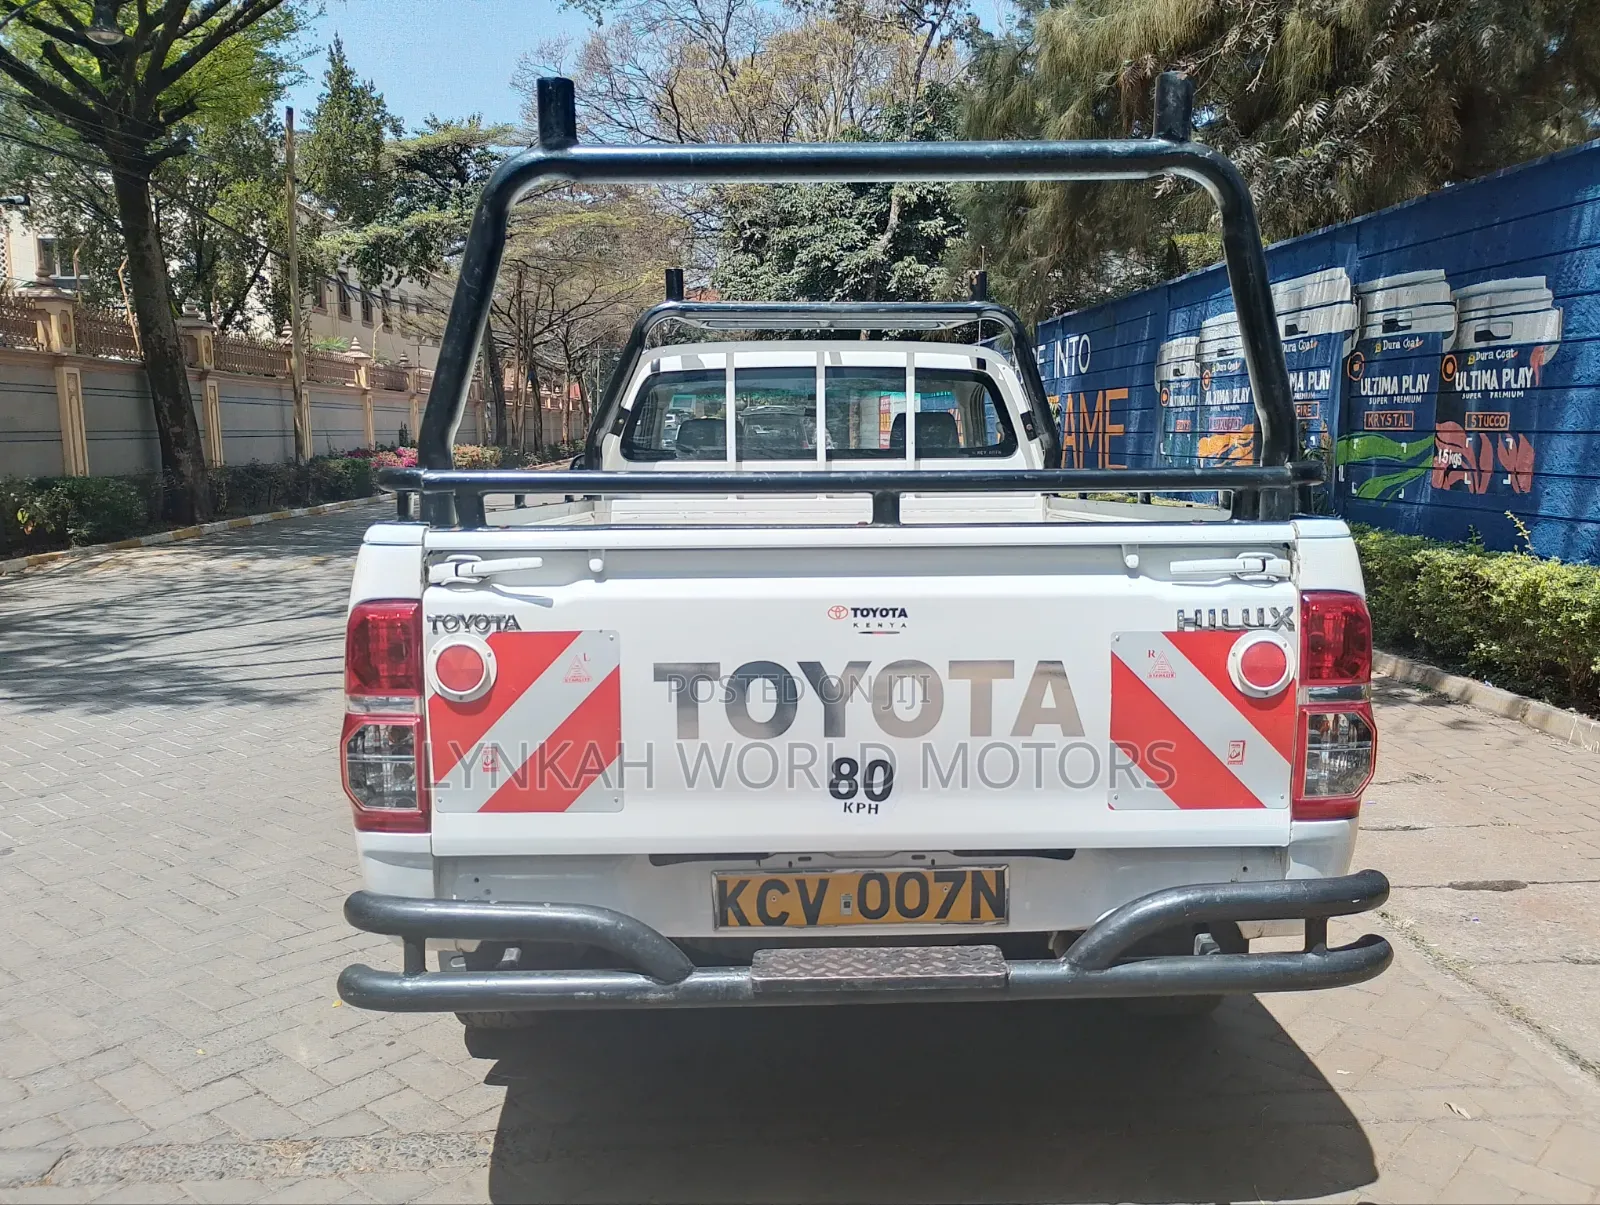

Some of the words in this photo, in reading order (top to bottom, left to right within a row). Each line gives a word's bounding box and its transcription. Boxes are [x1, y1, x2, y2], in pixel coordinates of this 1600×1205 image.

[1298, 339, 1316, 353] Coat
[1383, 339, 1401, 351] Dura
[1402, 336, 1421, 351] Coat
[1054, 334, 1091, 379] INTO
[1475, 351, 1494, 361] Dura
[1495, 348, 1516, 361] Coat
[1308, 370, 1331, 391] PLAY
[1360, 375, 1399, 396] ULTIMA
[1402, 373, 1430, 394] PLAY
[1454, 369, 1500, 391] ULTIMA
[1502, 366, 1534, 389] PLAY
[1232, 387, 1251, 404] PLAY
[1369, 397, 1388, 405] SUPER
[1393, 395, 1422, 404] PREMIUM
[1462, 392, 1482, 400] SUPER
[1489, 390, 1524, 399] PREMIUM
[1047, 388, 1128, 470] AME
[1367, 413, 1409, 427] KRYSTAL
[1471, 415, 1507, 428] STUCCO
[851, 607, 908, 618] TOYOTA
[1177, 606, 1295, 632] HILUX
[427, 614, 522, 635] TOYOTA
[653, 660, 1086, 740] TOYOTA
[828, 757, 895, 802] 80
[843, 801, 879, 815] KPH
[717, 877, 831, 926] KCV
[856, 871, 1006, 920] 007N
